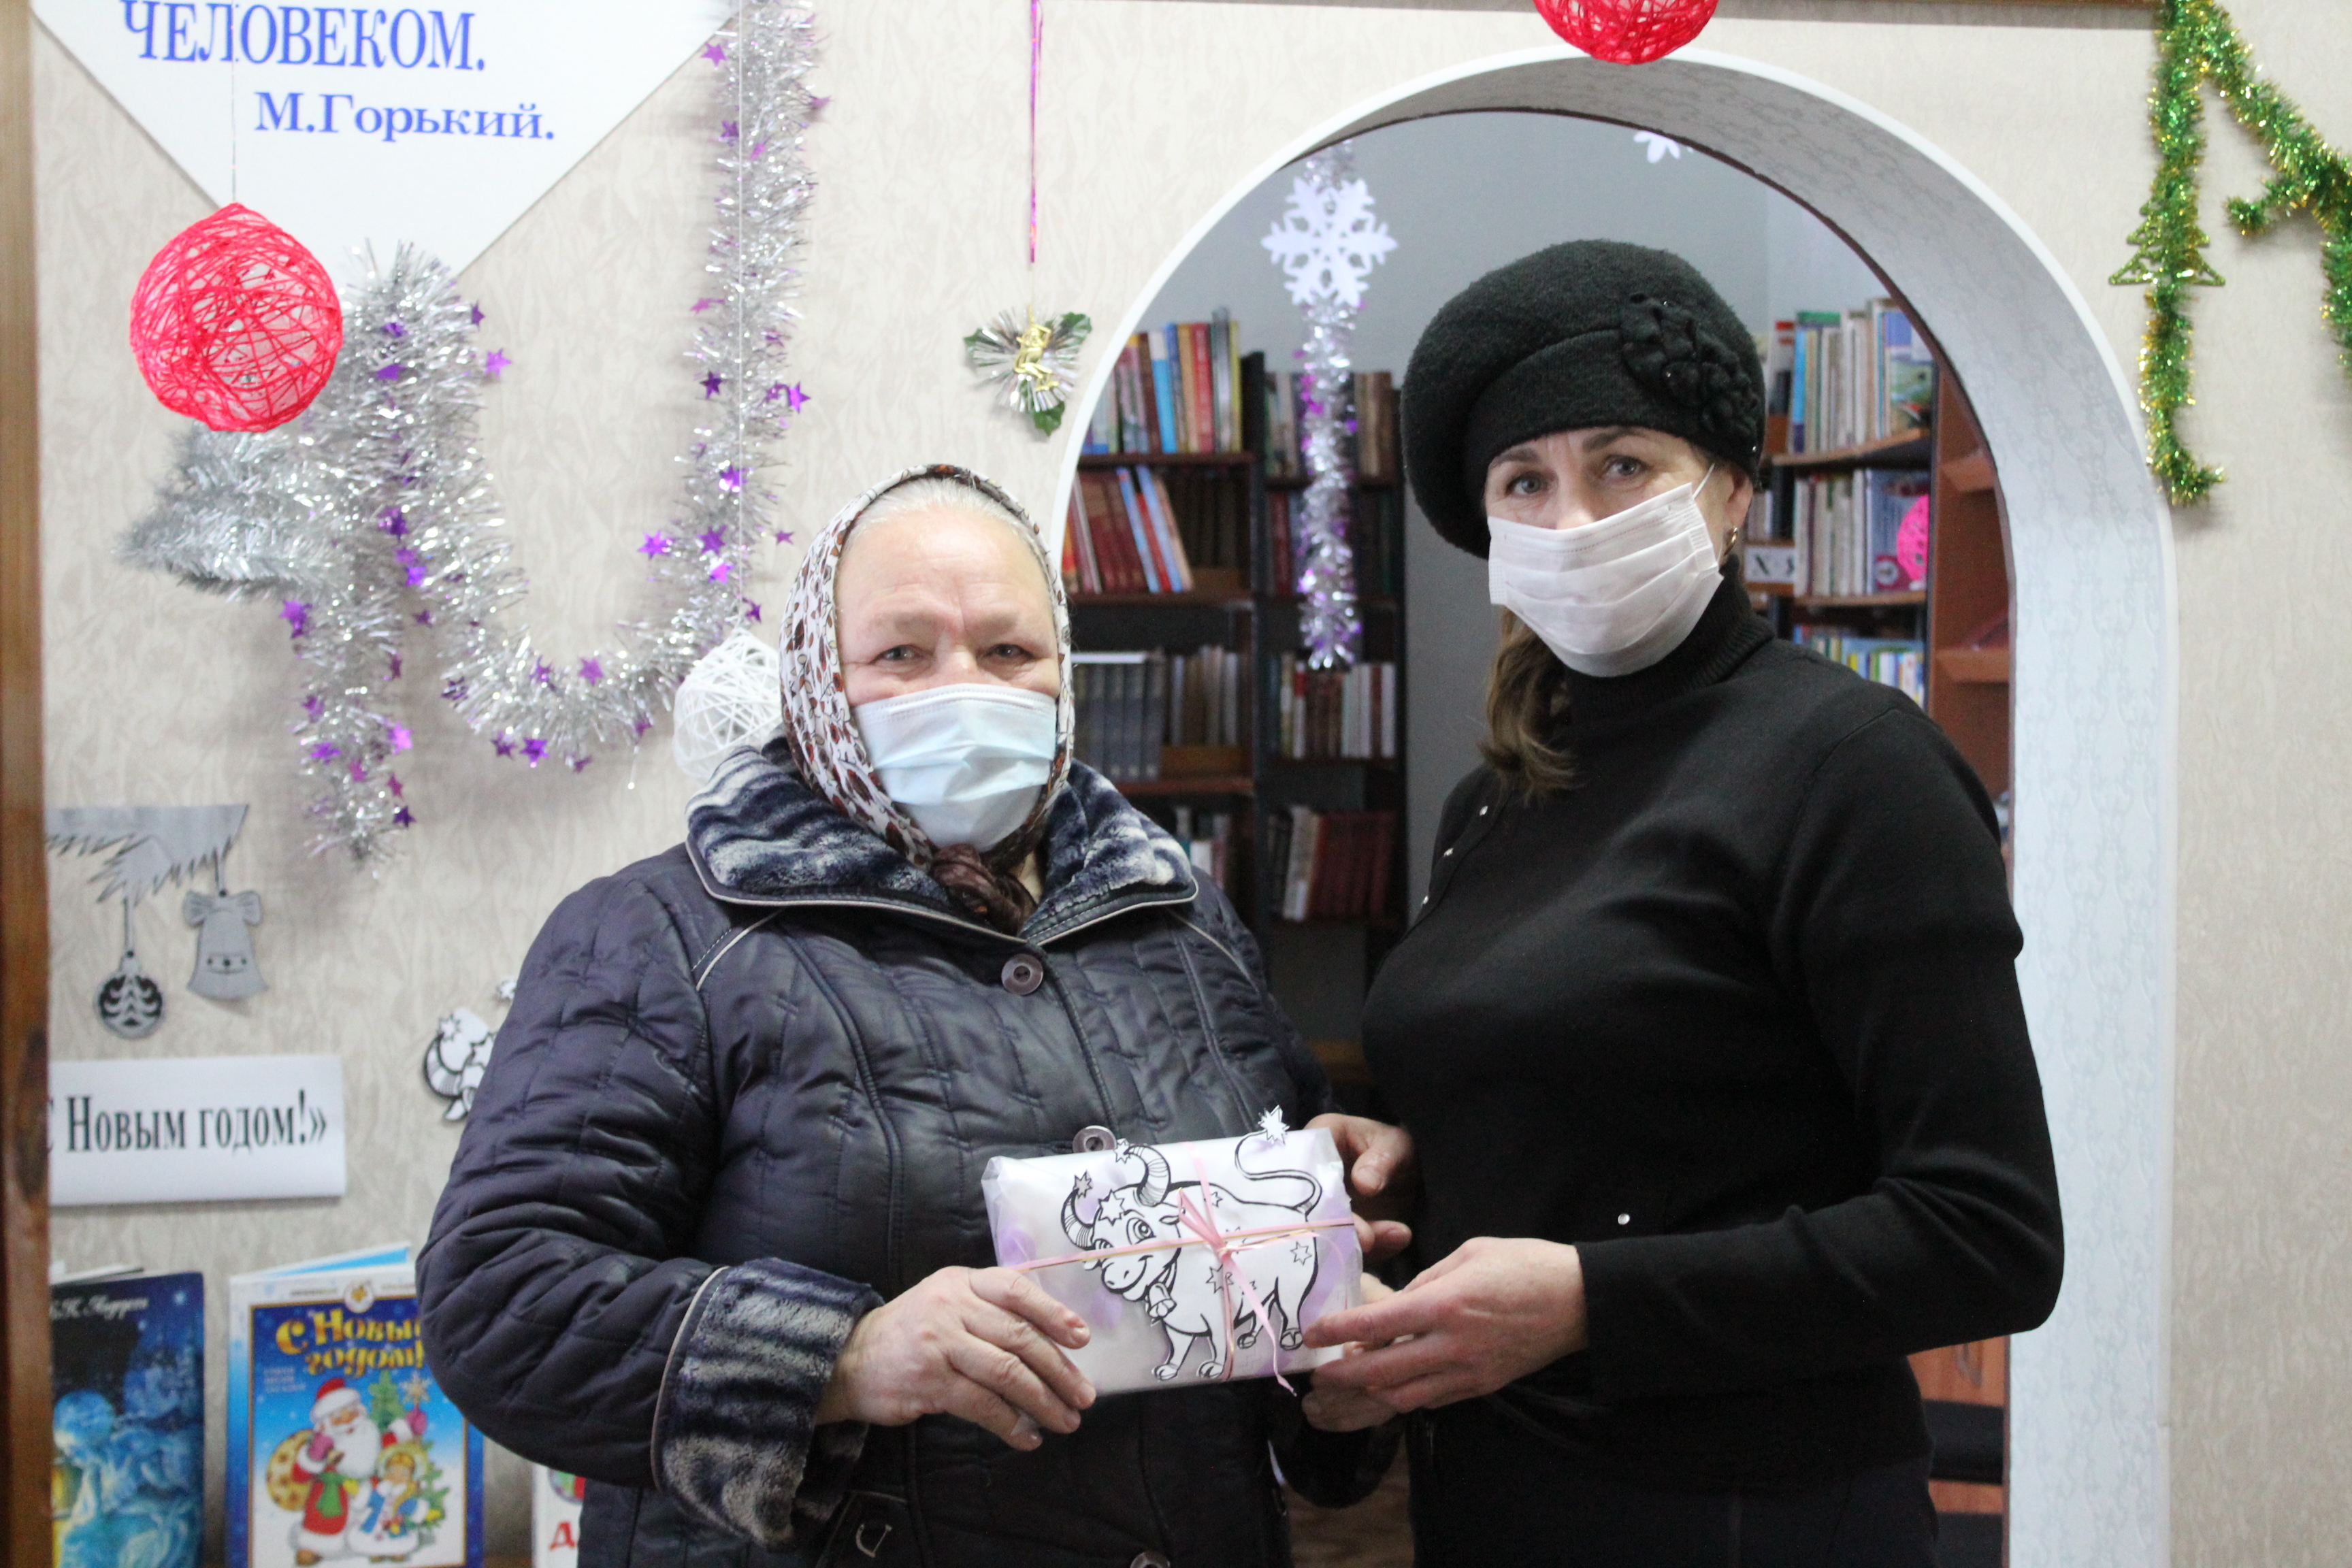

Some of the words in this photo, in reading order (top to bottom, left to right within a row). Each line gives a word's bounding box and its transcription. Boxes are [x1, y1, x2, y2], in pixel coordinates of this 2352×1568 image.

[119, 0, 485, 71] ЧЕЛОВЕКОМ.
[255, 91, 555, 142] М.Горький.
[66, 1095, 186, 1152] Новым
[199, 1089, 327, 1150] годом!»
